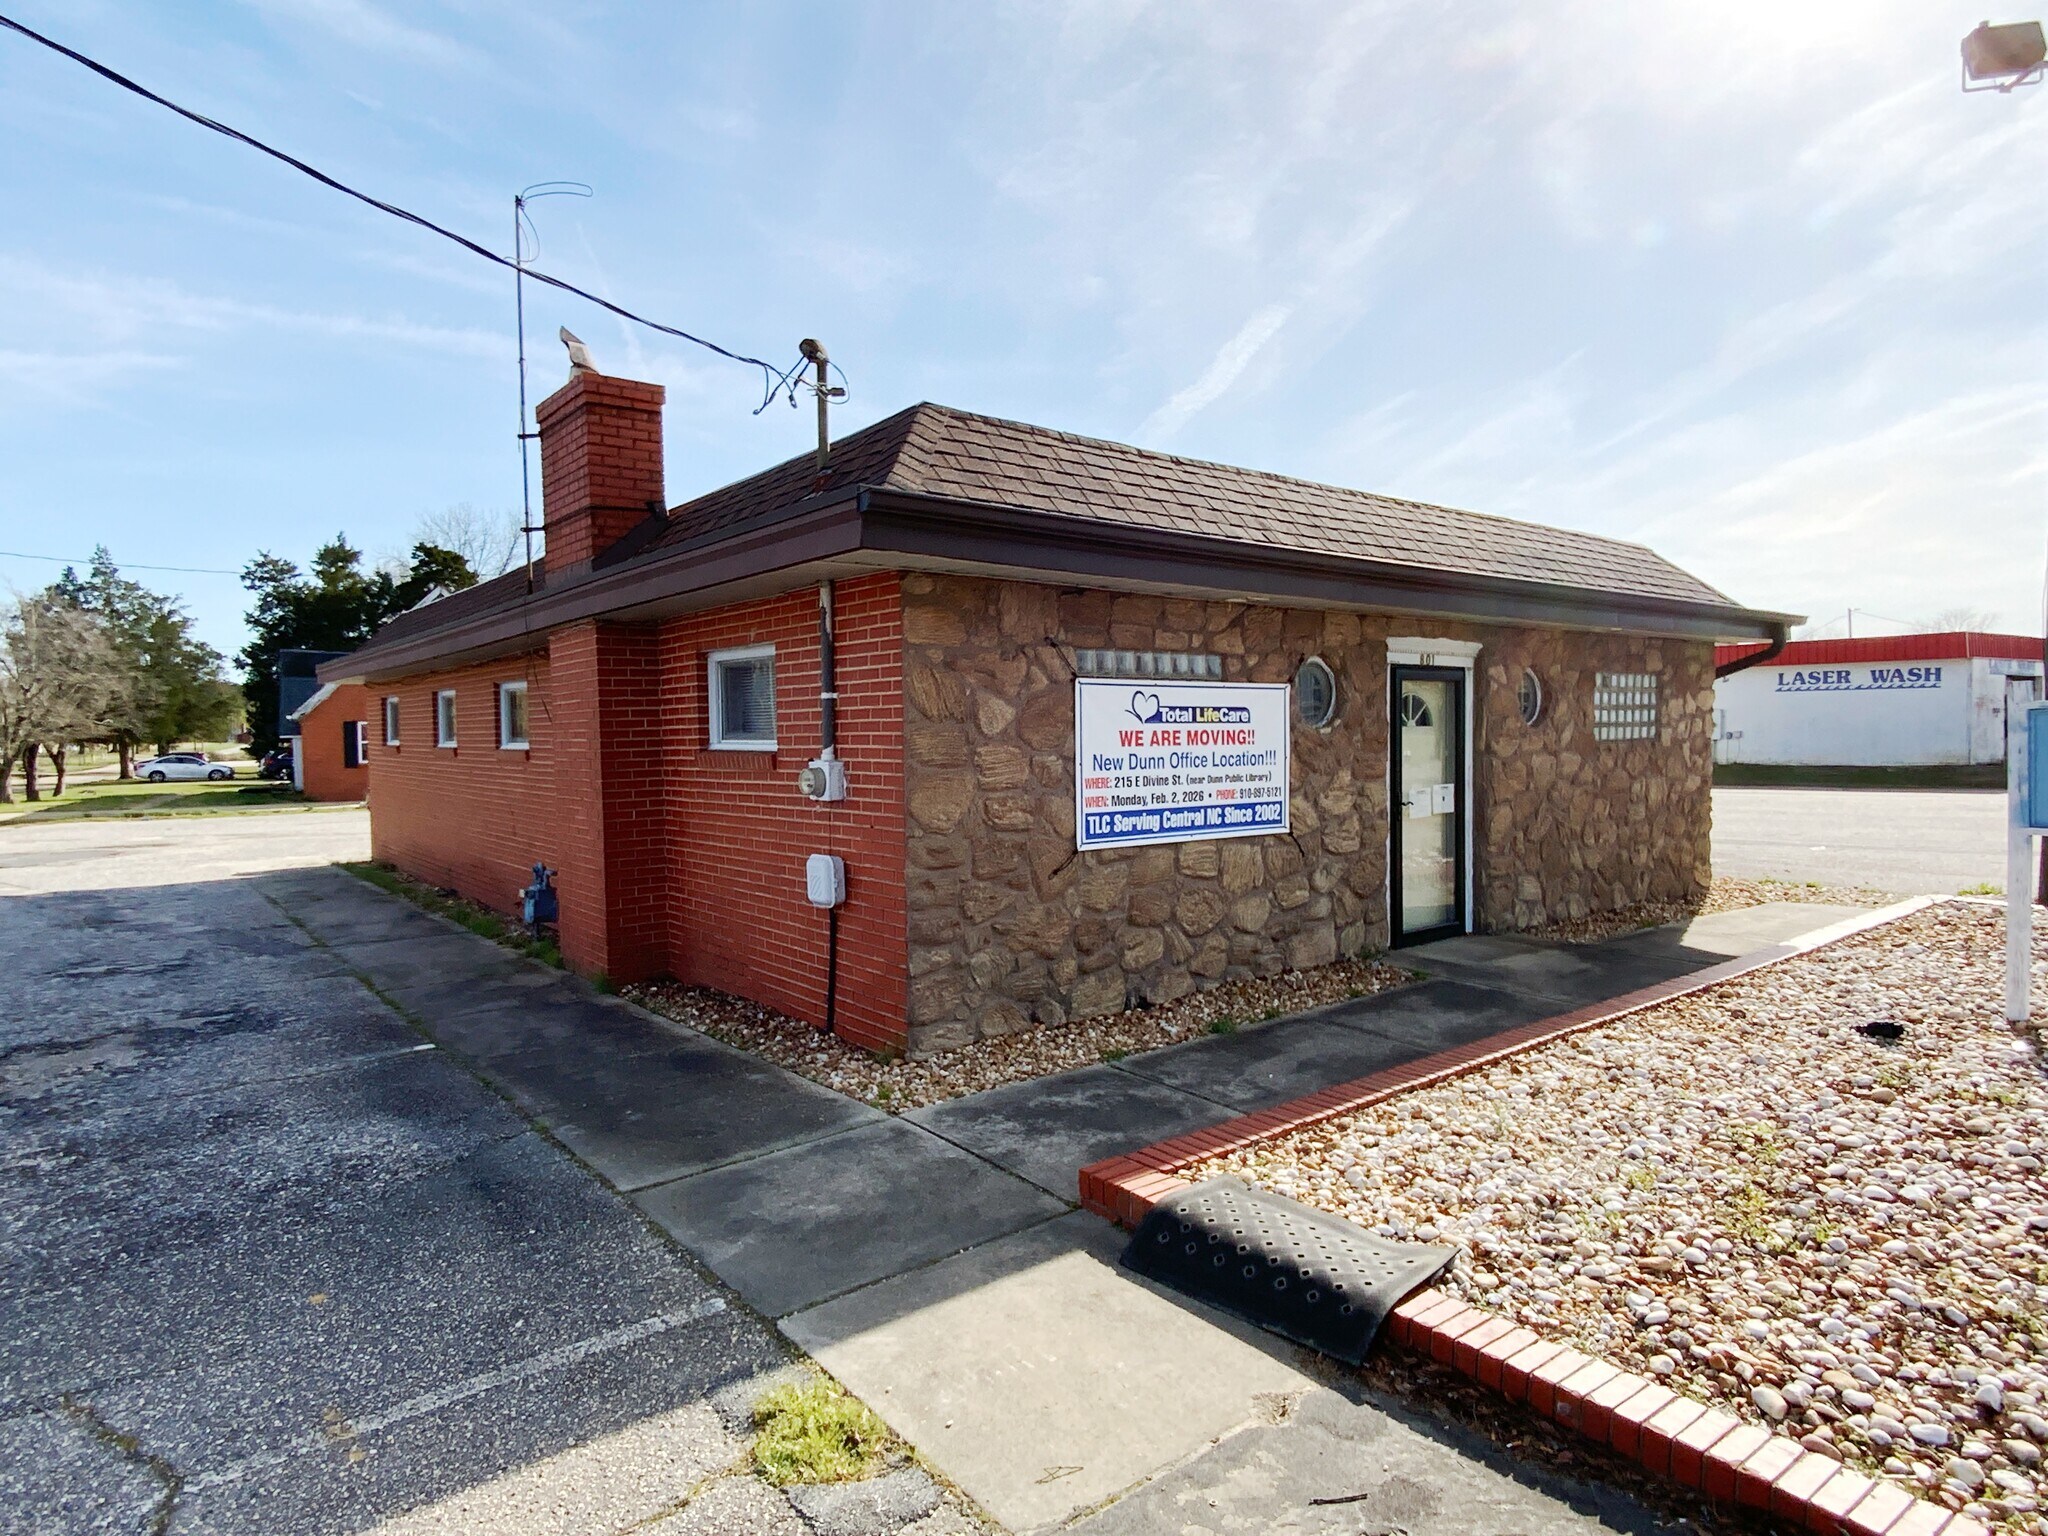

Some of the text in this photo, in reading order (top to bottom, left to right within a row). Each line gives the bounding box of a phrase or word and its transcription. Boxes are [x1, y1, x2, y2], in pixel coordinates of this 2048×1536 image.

[1420, 653, 1435, 665] 801
[1778, 667, 1942, 686] LASER WASH
[1159, 707, 1249, 723] Total LifeCare
[1119, 729, 1255, 747] WE ARE MOVING!!
[1093, 750, 1277, 771] New Dunn Office Location!!!
[1084, 771, 1272, 789] WHERE: 215 E Divine St. (near Dunn Public Library)
[1085, 796, 1109, 808] WHEN:
[1111, 794, 1148, 807] Monday,
[1151, 793, 1169, 804] Feb.
[1171, 792, 1180, 804] 2,
[1182, 791, 1204, 803] 2026
[1215, 789, 1238, 800] PHONE:
[1087, 803, 1281, 835] TLC Serving Central NC Since 2002
